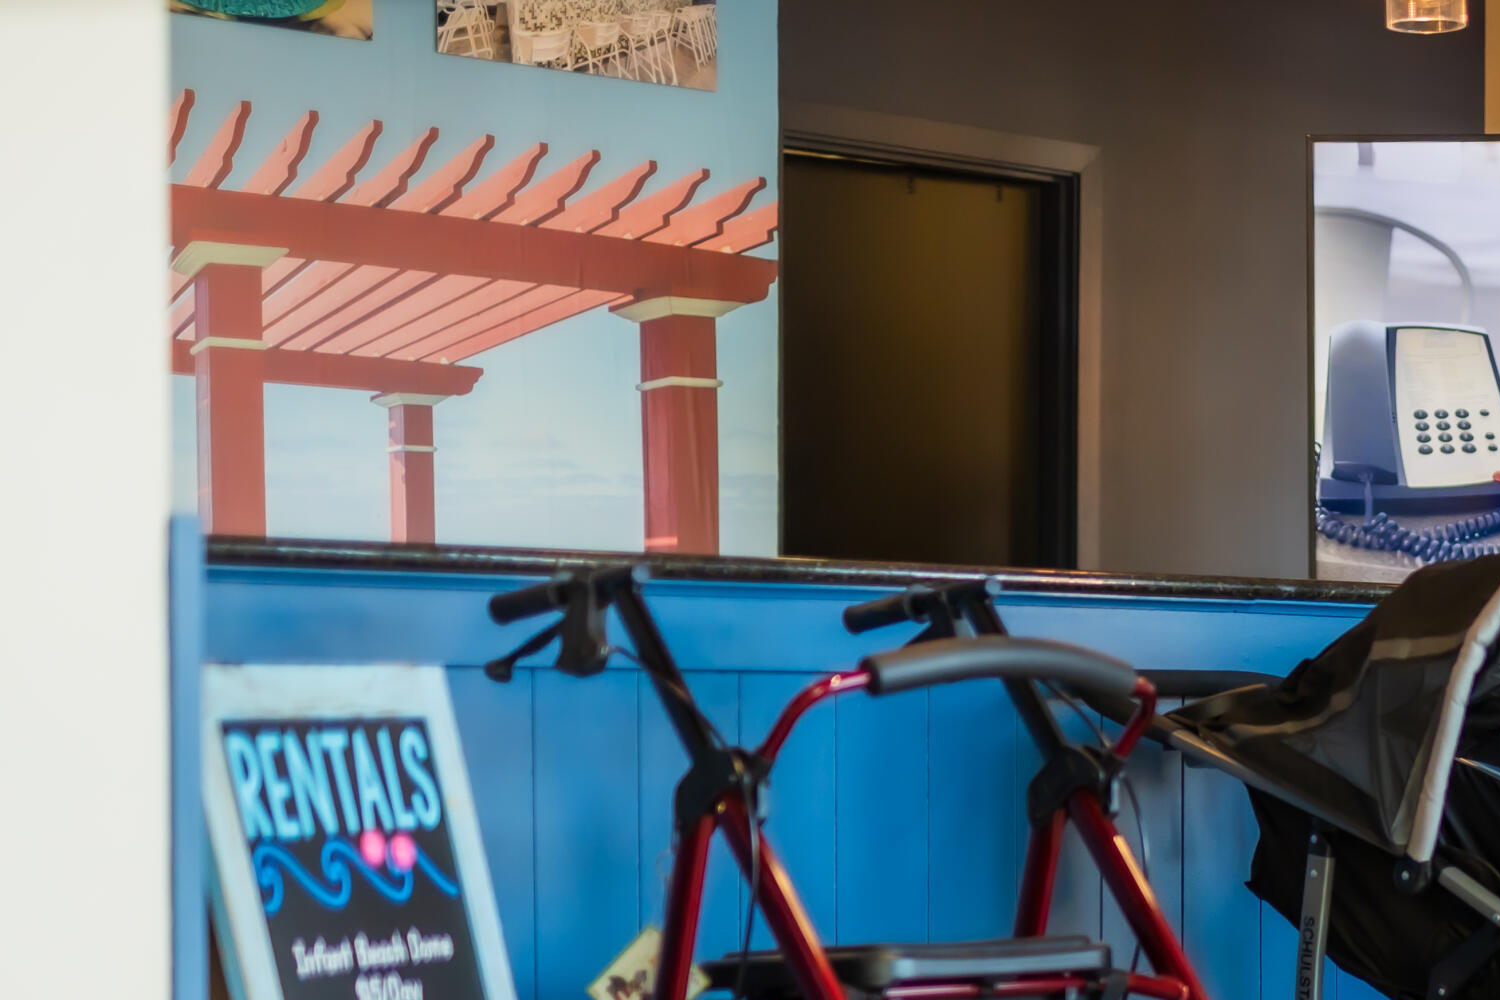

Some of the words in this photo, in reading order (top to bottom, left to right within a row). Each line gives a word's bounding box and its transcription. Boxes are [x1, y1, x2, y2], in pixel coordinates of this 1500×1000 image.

[225, 725, 441, 839] RENTALS
[292, 935, 354, 981] Infant
[407, 925, 454, 966] Dome
